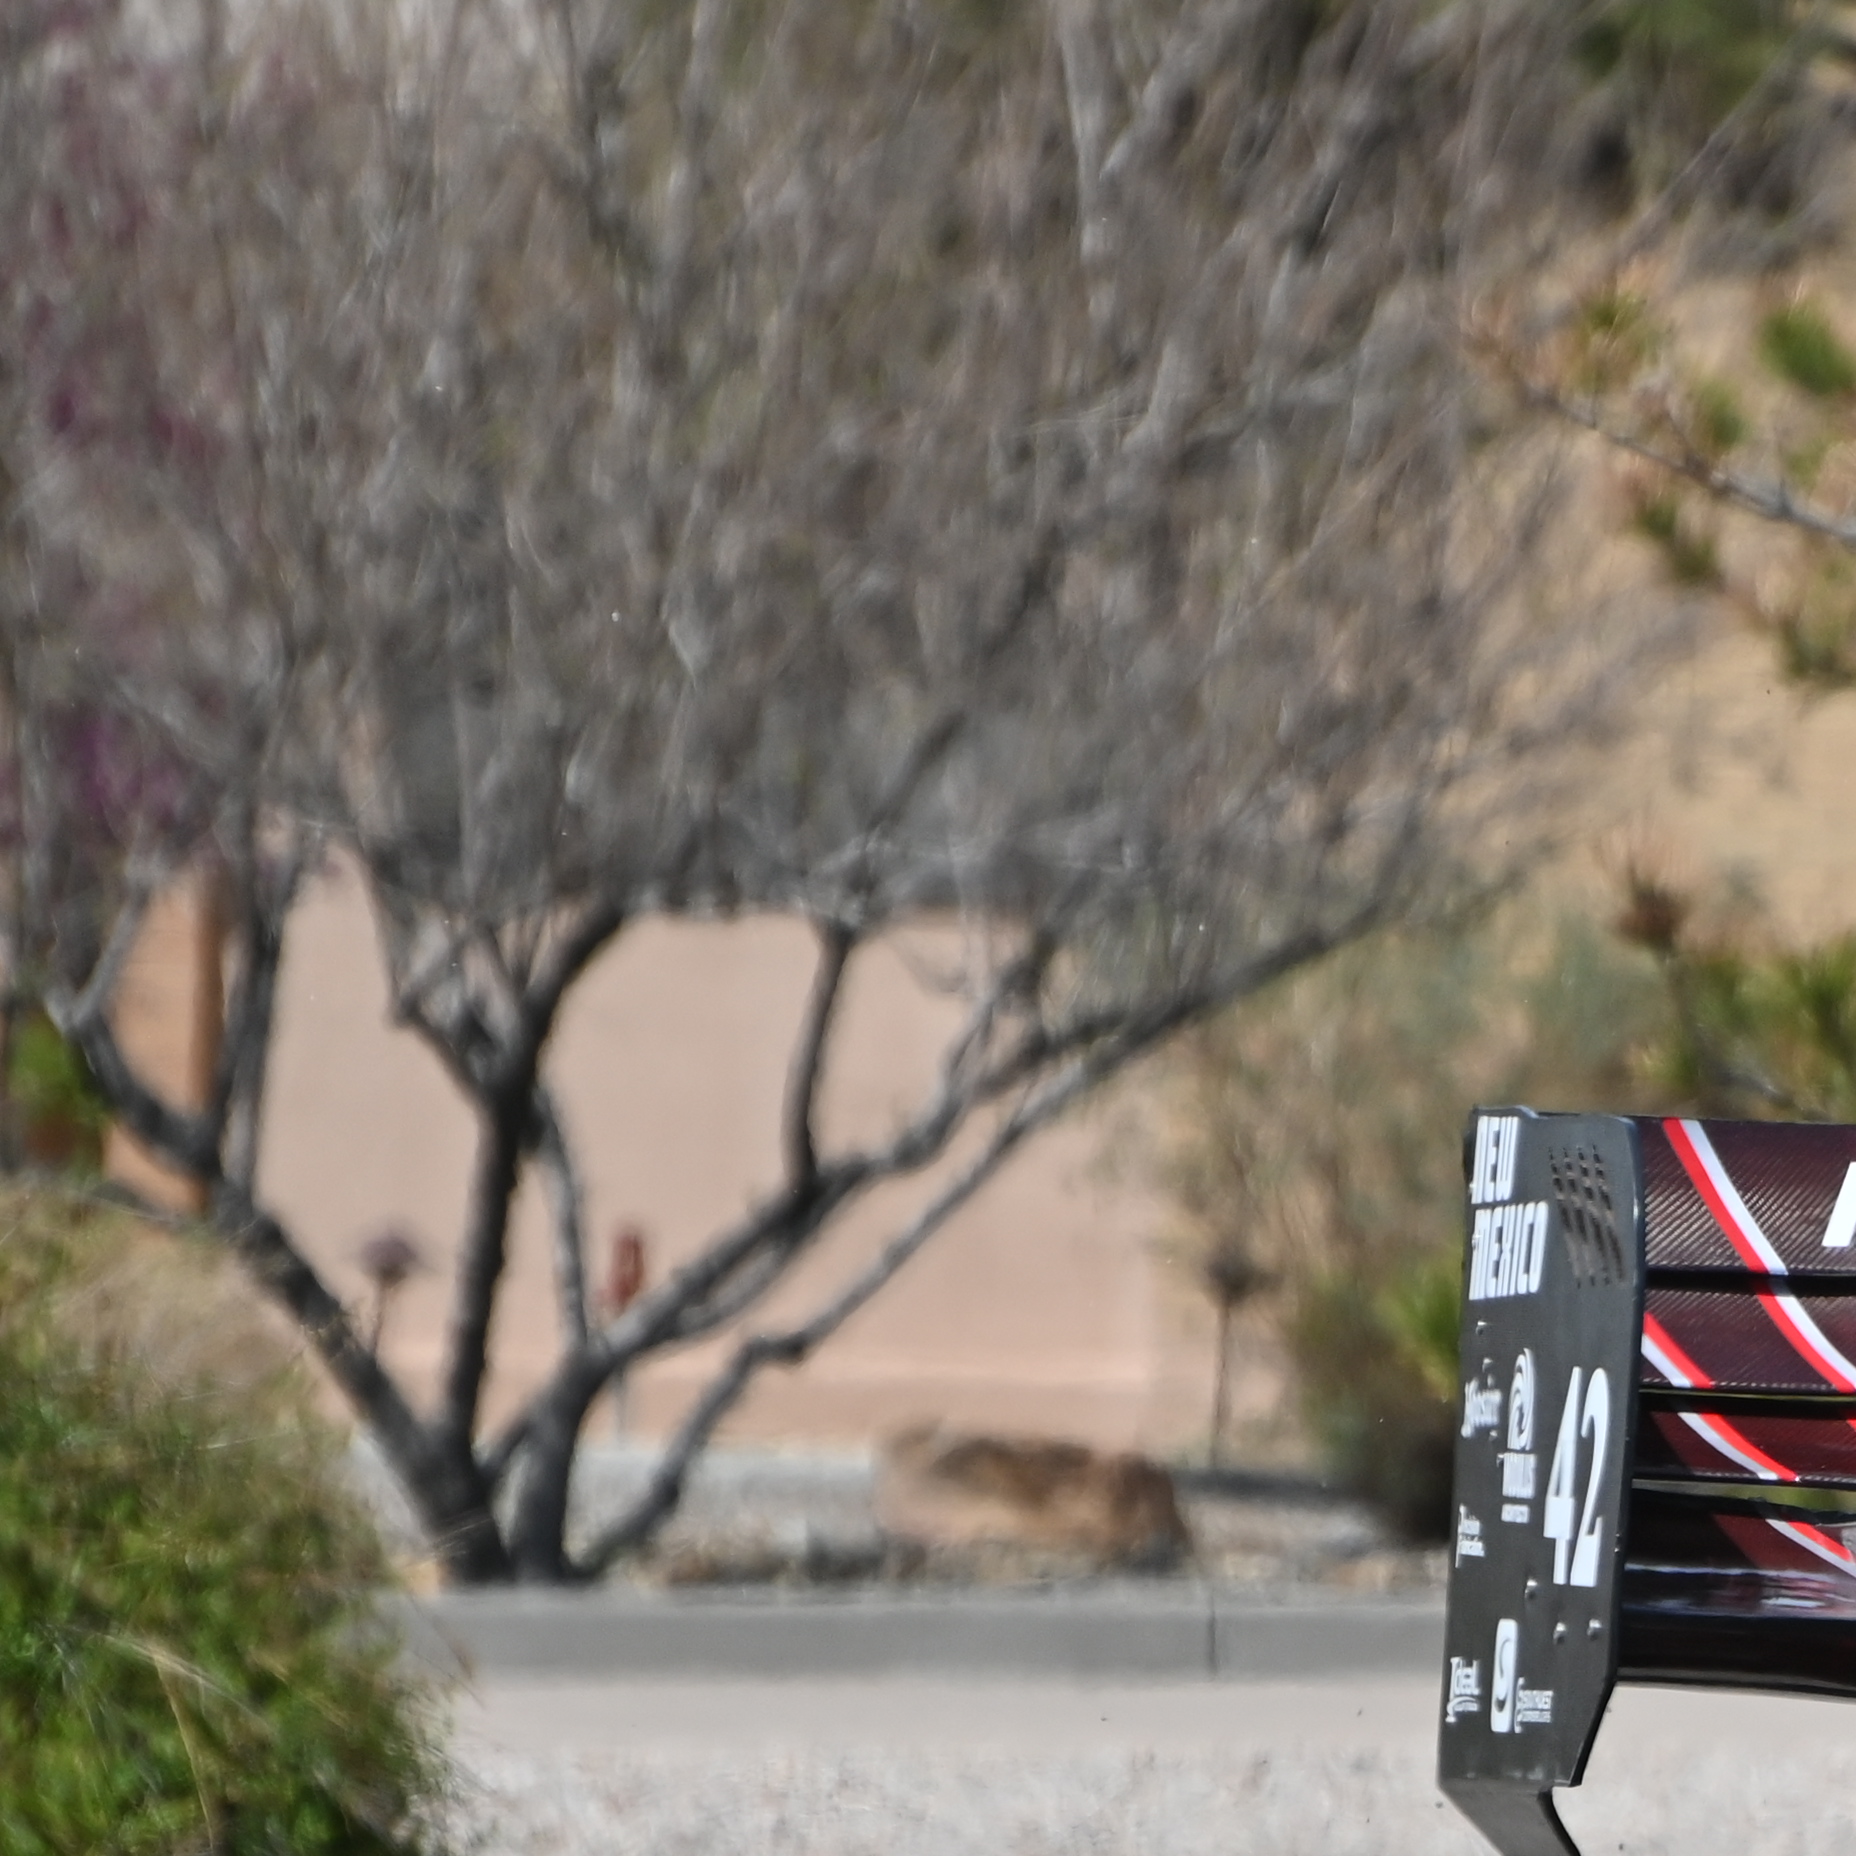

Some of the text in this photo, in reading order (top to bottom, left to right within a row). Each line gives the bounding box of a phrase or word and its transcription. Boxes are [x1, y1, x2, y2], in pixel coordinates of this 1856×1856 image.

[1470, 1115, 1520, 1205] NEW
[1468, 1200, 1550, 1301] MEXICO
[1543, 1365, 1610, 1588] 42
